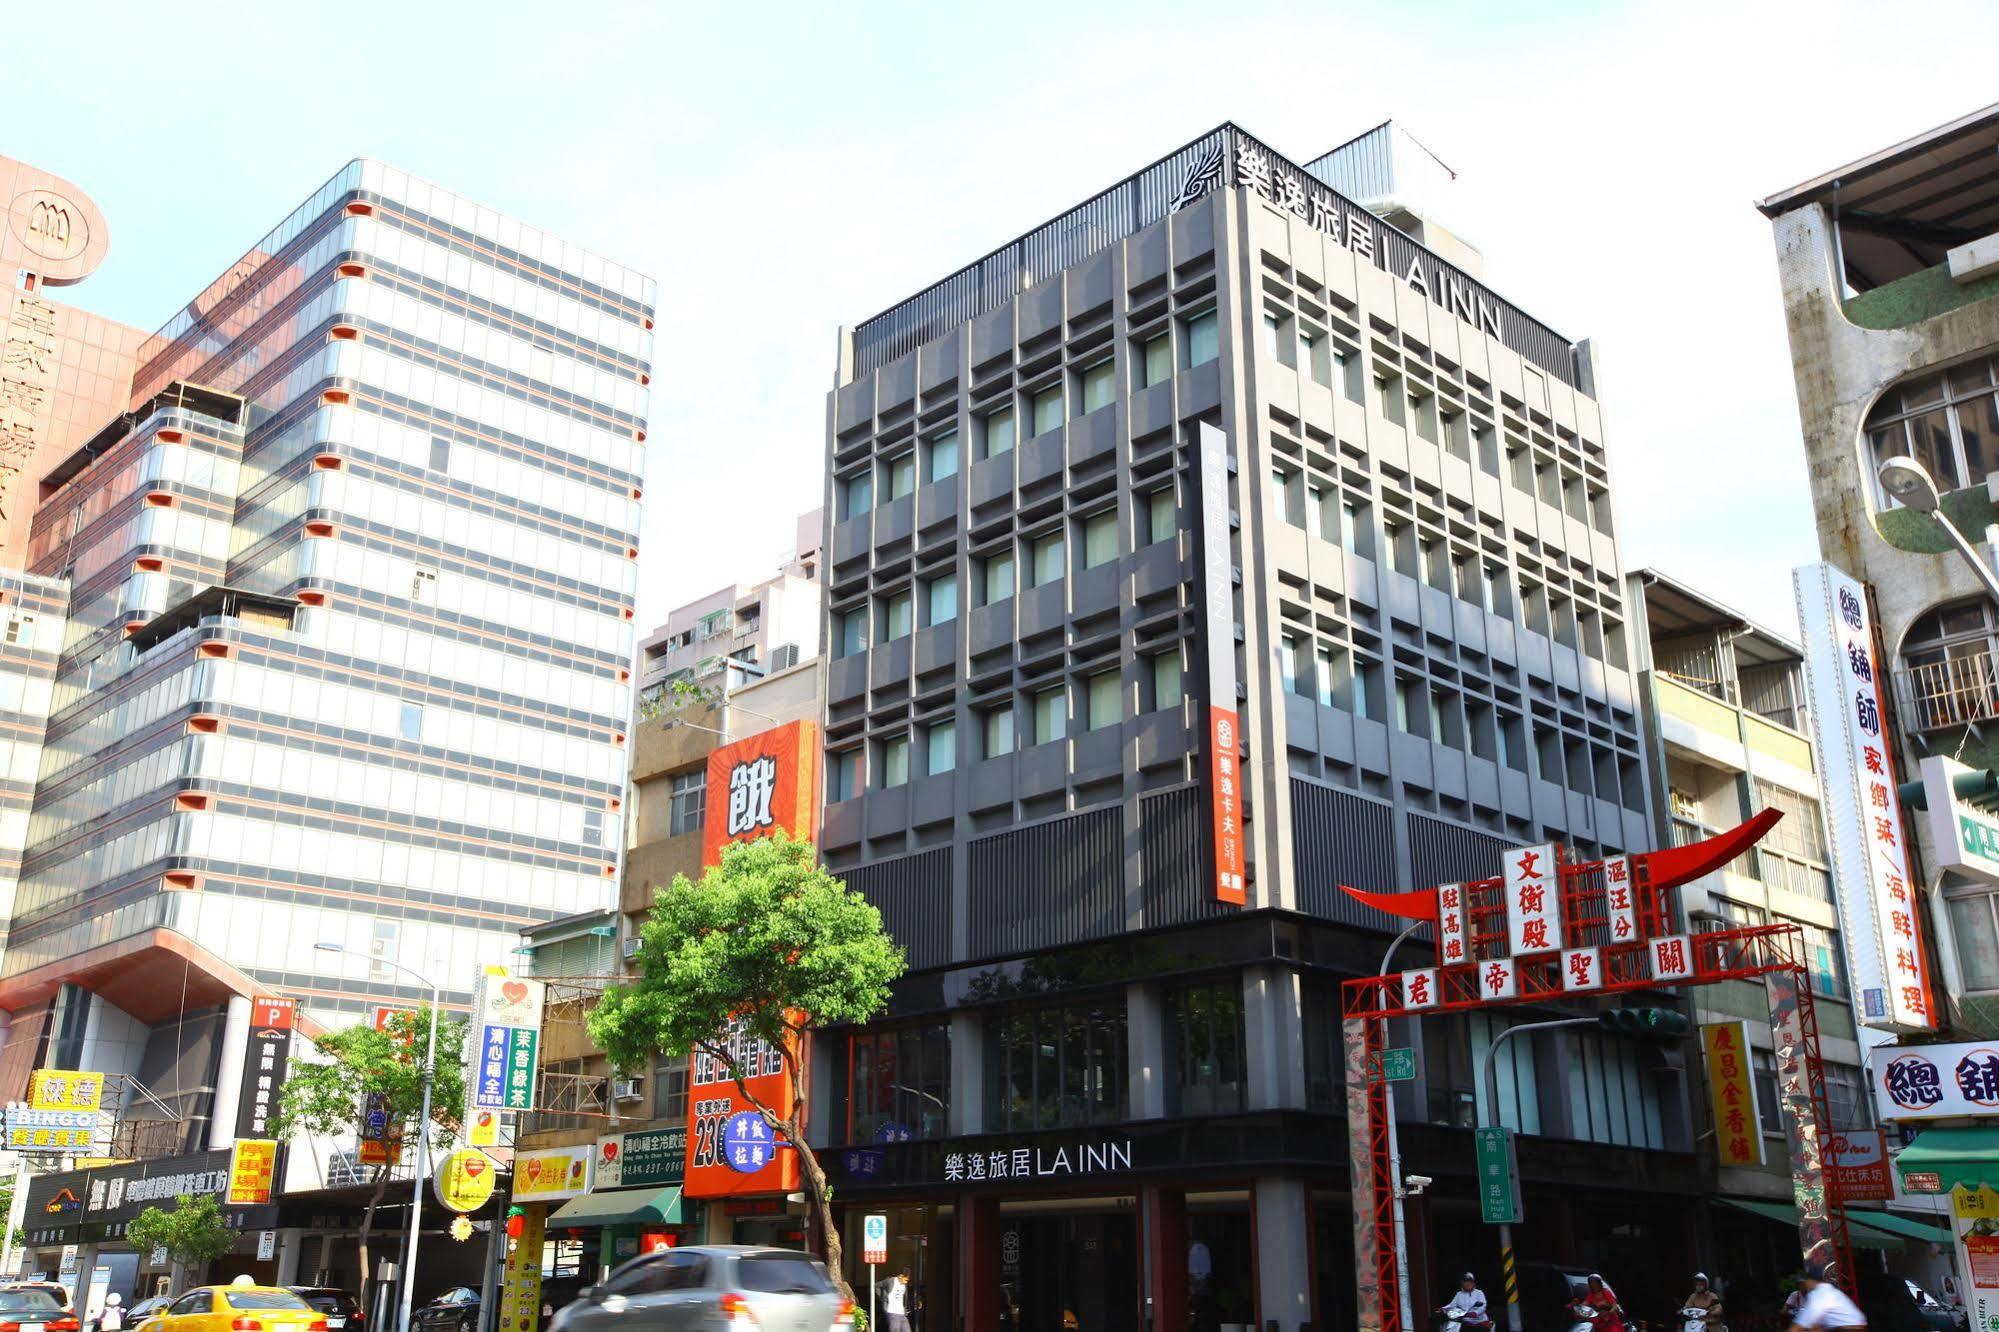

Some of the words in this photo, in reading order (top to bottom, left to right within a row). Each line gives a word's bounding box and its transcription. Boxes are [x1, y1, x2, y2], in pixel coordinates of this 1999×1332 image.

[1236, 144, 1374, 264] 樂逸旅居
[1380, 236, 1433, 305] LA
[1439, 270, 1504, 346] INN
[1441, 888, 1464, 961] 駐高雄
[1516, 850, 1551, 950] 文衡殿
[268, 1008, 281, 1026] P
[484, 1027, 506, 1095] 清心福全
[510, 1030, 532, 1107] 茉香綠茶
[16, 1109, 92, 1127] BINGO
[944, 1149, 1031, 1181] 樂逸旅居
[1036, 1147, 1073, 1176] LA
[1078, 1140, 1133, 1173] INN
